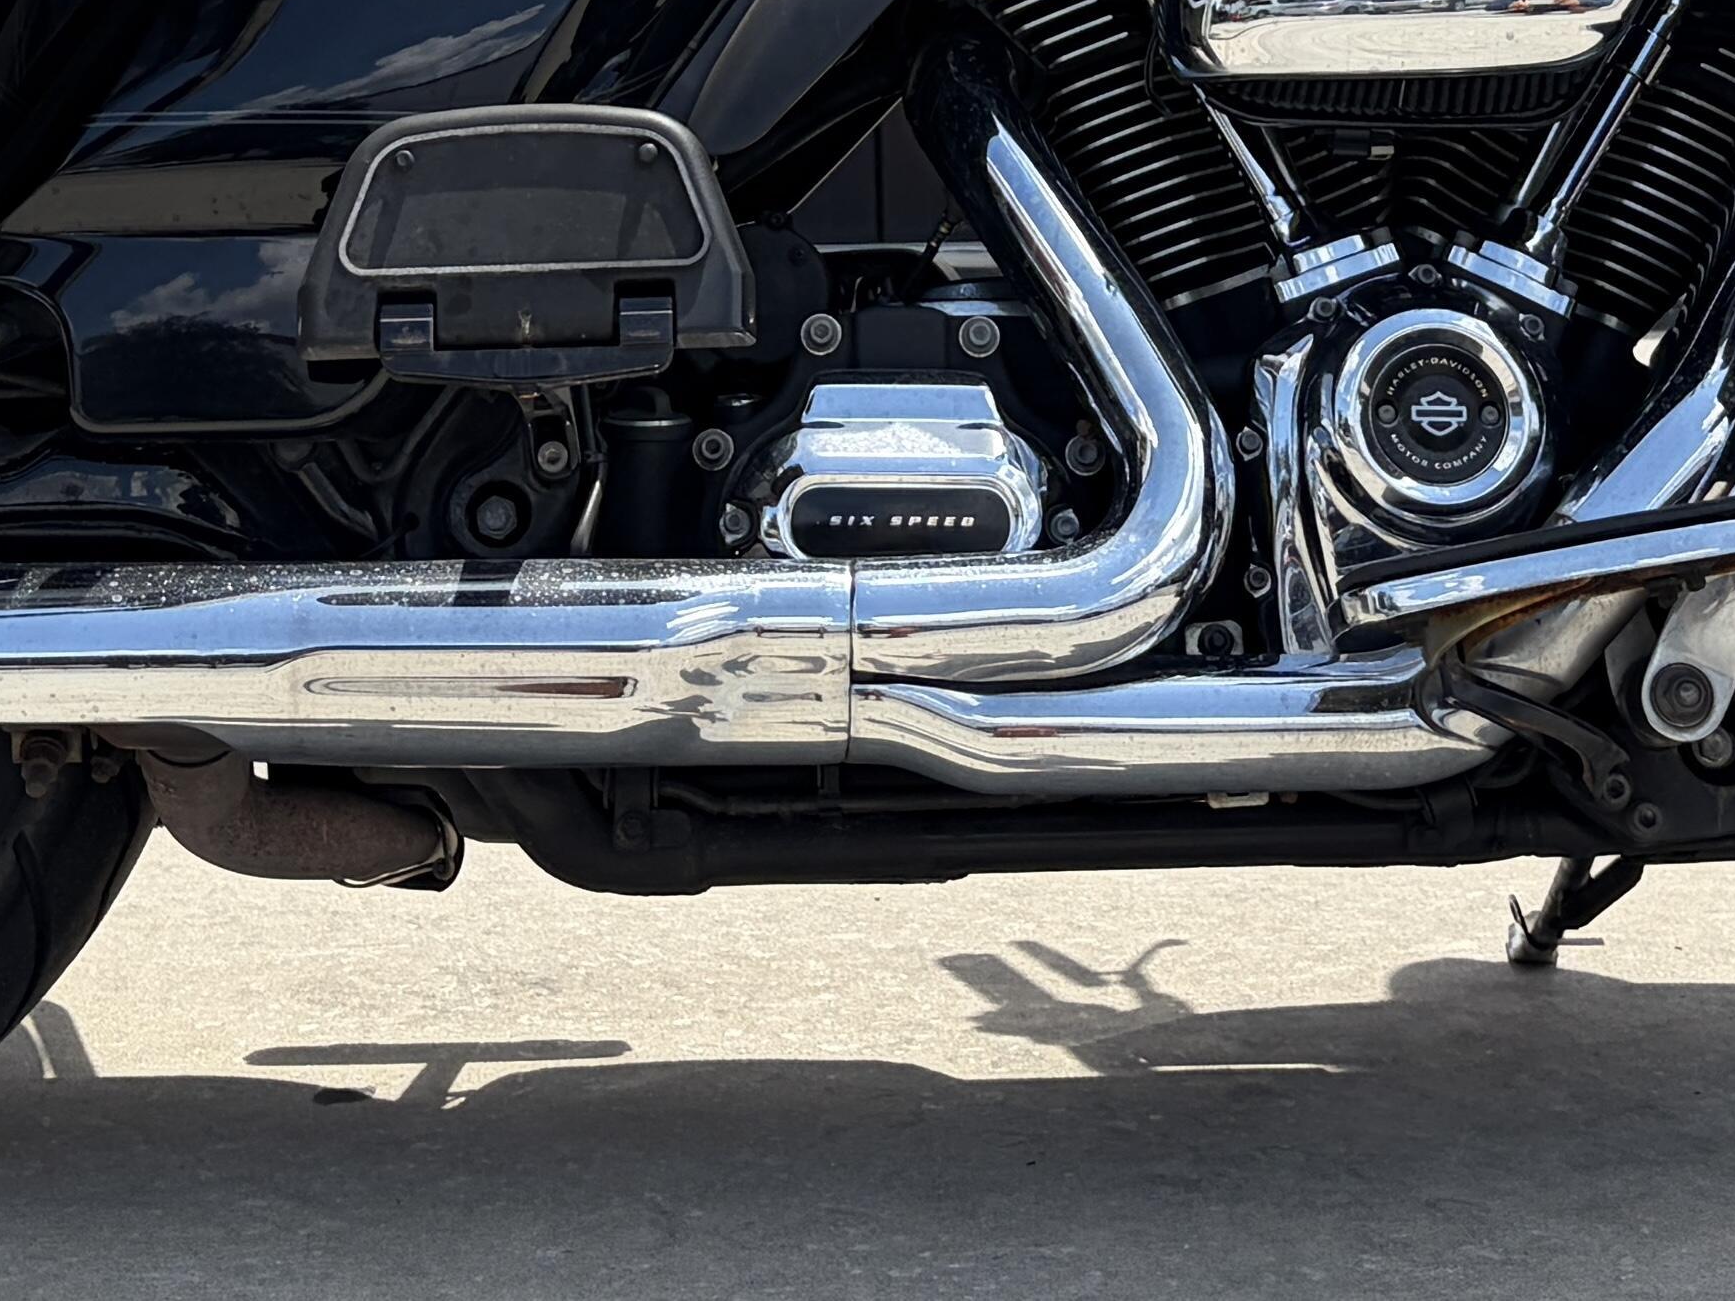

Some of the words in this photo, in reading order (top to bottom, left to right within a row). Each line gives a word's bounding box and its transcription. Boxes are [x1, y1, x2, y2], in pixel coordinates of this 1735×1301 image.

[1385, 356, 1490, 399] HARLEY-DAVIDSON
[1389, 433, 1430, 470] MOTOR
[1433, 434, 1489, 470] COMPANY
[828, 514, 876, 528] SIX
[889, 513, 978, 528] SPEED
